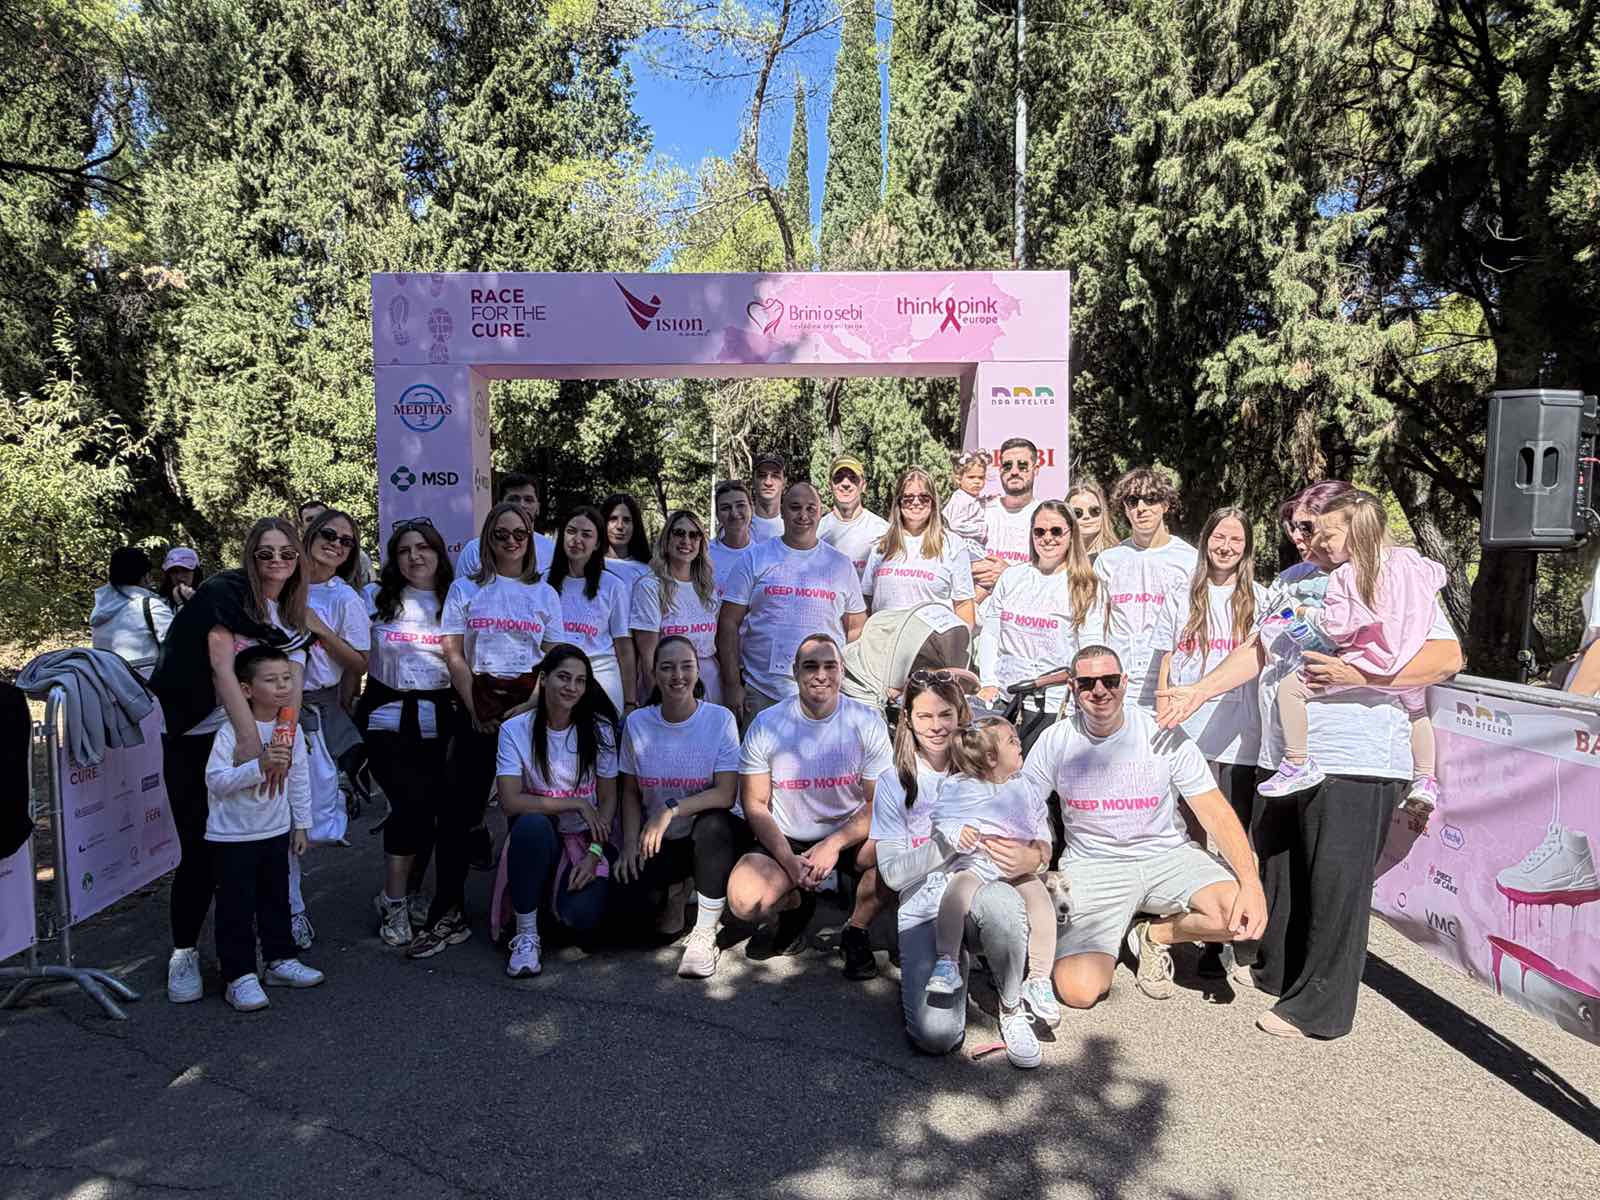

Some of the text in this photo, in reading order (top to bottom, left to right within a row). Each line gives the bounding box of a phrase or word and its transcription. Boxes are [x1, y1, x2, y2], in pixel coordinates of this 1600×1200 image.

[471, 289, 524, 304] RACE
[471, 306, 546, 320] FOR THE
[790, 304, 863, 320] Brini o sebi
[897, 297, 998, 318] think pink
[962, 316, 998, 325] europe
[394, 404, 452, 416] MEDITAS
[422, 471, 459, 486] MSD
[895, 568, 936, 582] MOVING
[764, 585, 836, 600] KEEP MOVING
[496, 618, 542, 634] MOVING
[1015, 614, 1059, 629] MOVING
[384, 632, 418, 642] KEEP
[1067, 796, 1160, 811] KEEP MOVING
[1425, 909, 1457, 937] VMC
